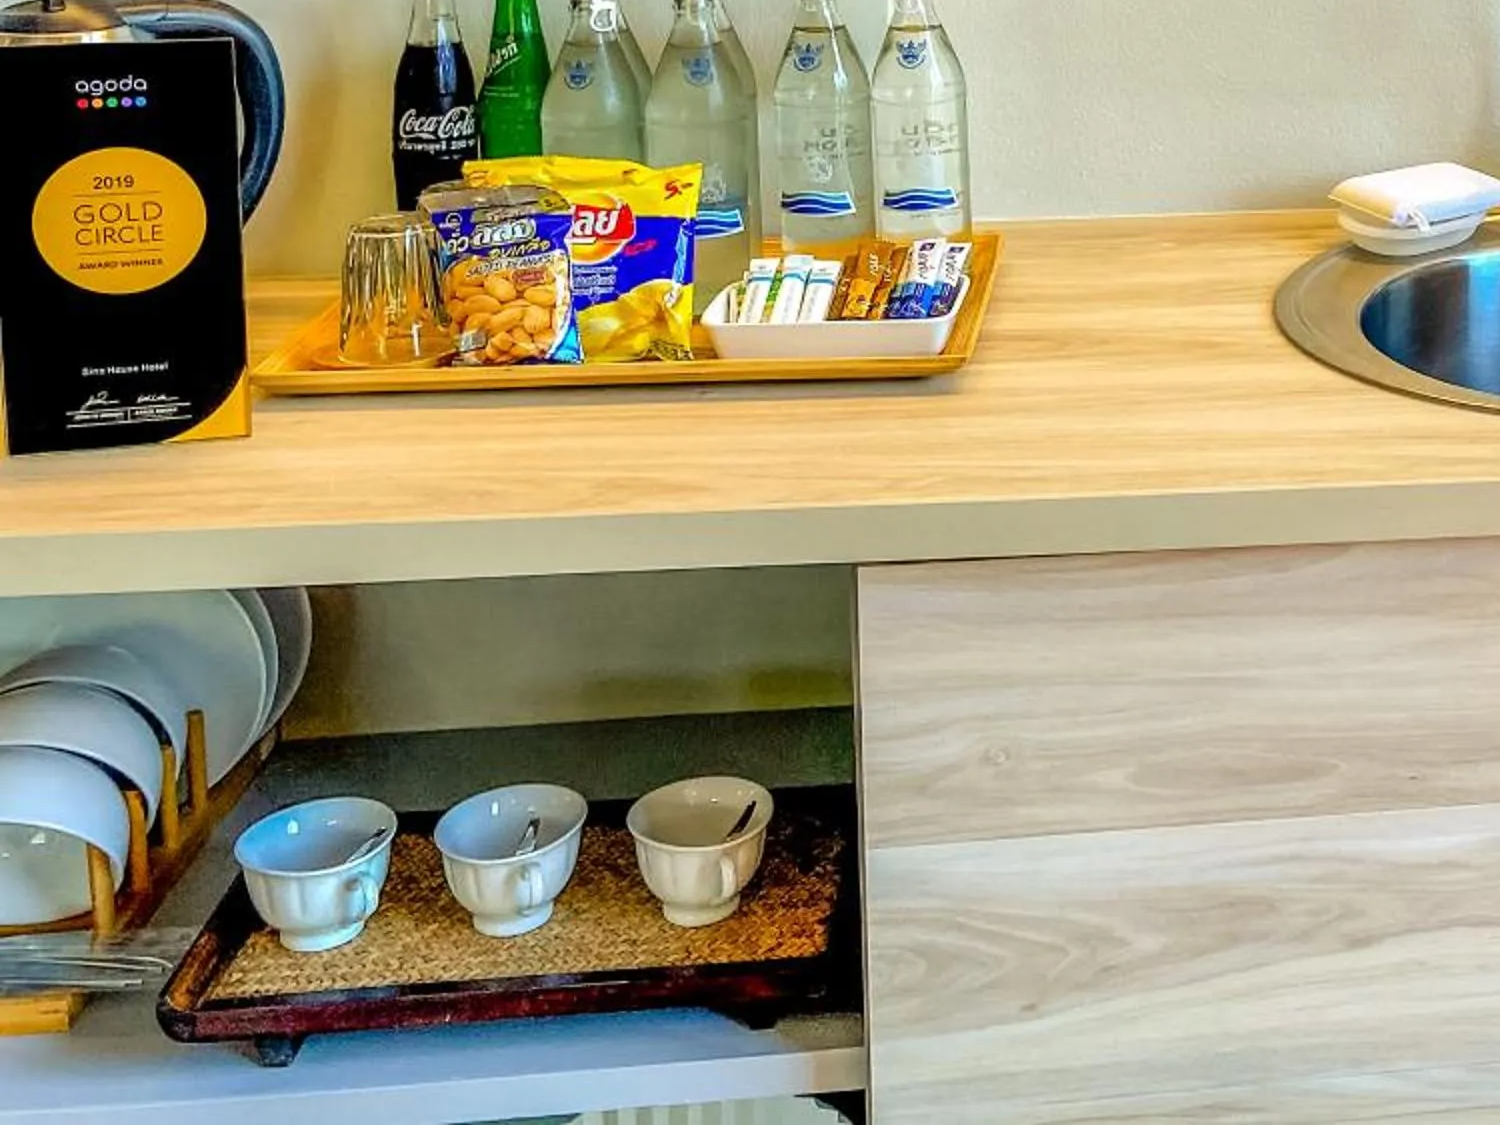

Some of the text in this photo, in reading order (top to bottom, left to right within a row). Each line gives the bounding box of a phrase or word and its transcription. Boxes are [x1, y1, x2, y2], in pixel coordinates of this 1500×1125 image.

[75, 74, 147, 96] agoda
[93, 174, 135, 190] 2019
[73, 200, 163, 224] GOLD
[572, 197, 624, 238] ลย์
[75, 224, 165, 246] CIRCLE
[79, 257, 163, 270] AWARD WINNER
[140, 360, 169, 372] Hotel
